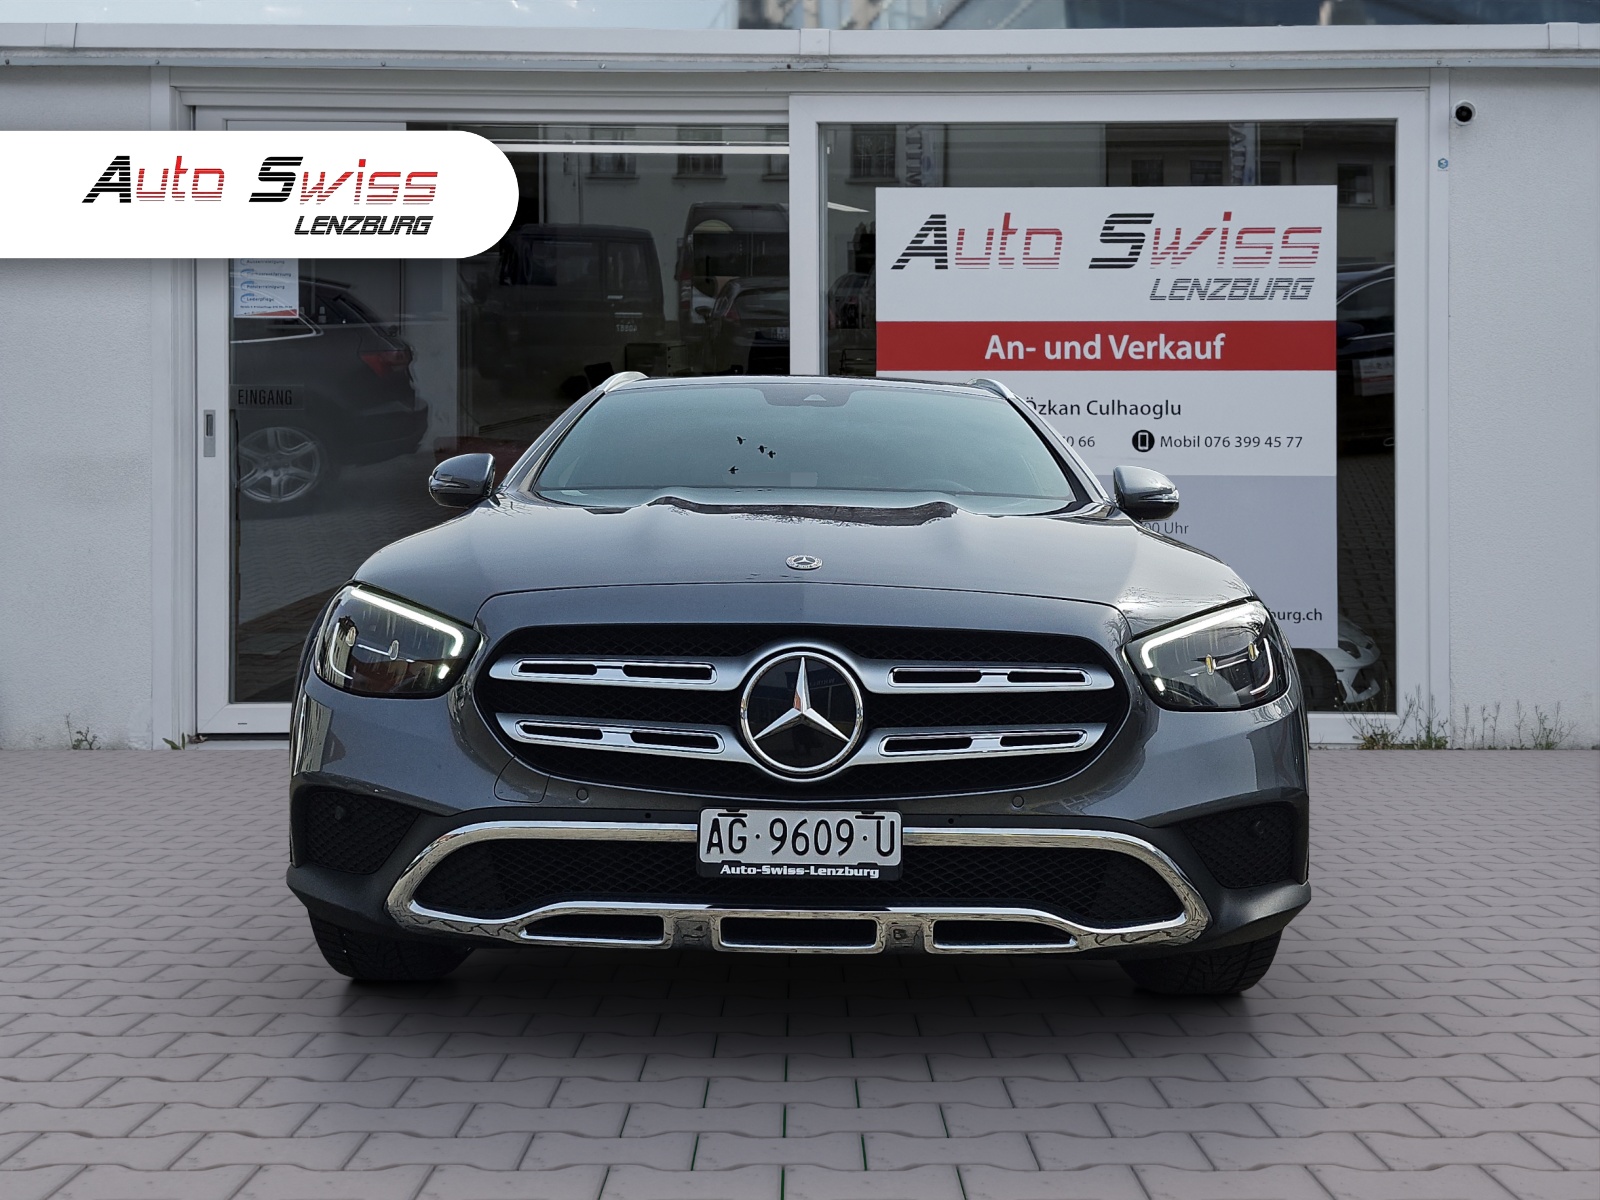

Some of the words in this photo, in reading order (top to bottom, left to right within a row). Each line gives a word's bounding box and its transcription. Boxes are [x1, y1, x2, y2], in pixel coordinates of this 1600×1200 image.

[890, 211, 1063, 271] Auto
[1087, 210, 1323, 270] Swiss
[1149, 277, 1316, 302] LENZBURG
[985, 334, 1037, 360] An-
[1044, 333, 1101, 360] und
[1107, 332, 1225, 360] Verkauf
[237, 389, 293, 405] EINGANG
[1086, 399, 1182, 420] Culhaoglu
[1078, 435, 1096, 448] 66
[1160, 435, 1200, 448] Mobil
[1204, 435, 1231, 448] 076
[1234, 435, 1261, 448] 399
[1264, 436, 1282, 448] 45
[1286, 436, 1303, 448] 77
[1164, 521, 1189, 535] Uhr
[720, 864, 880, 879] Auto-Swiss-Lenzburg
